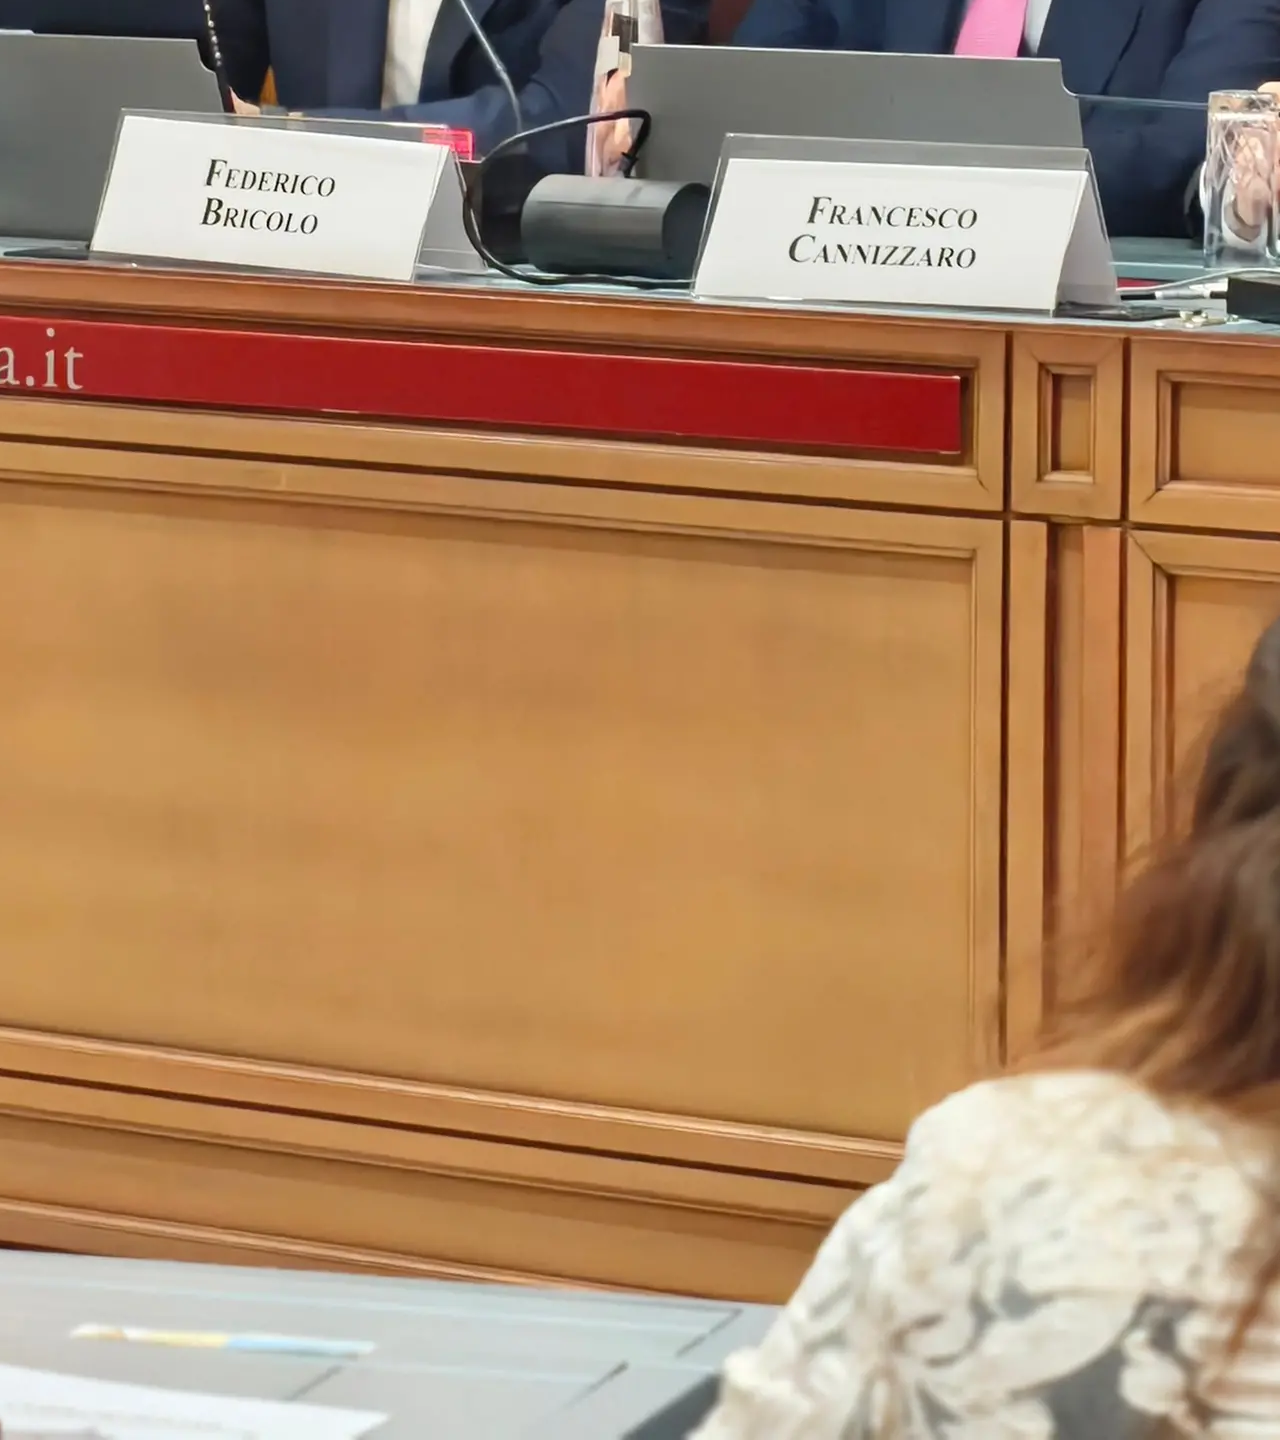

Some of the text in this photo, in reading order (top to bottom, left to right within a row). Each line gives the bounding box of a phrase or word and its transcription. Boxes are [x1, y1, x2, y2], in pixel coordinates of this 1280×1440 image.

[204, 159, 337, 197] FEDERICO
[200, 197, 319, 235] BRICOLO
[806, 196, 979, 229] FRANCESCO
[787, 234, 977, 269] CANNIZZARO
